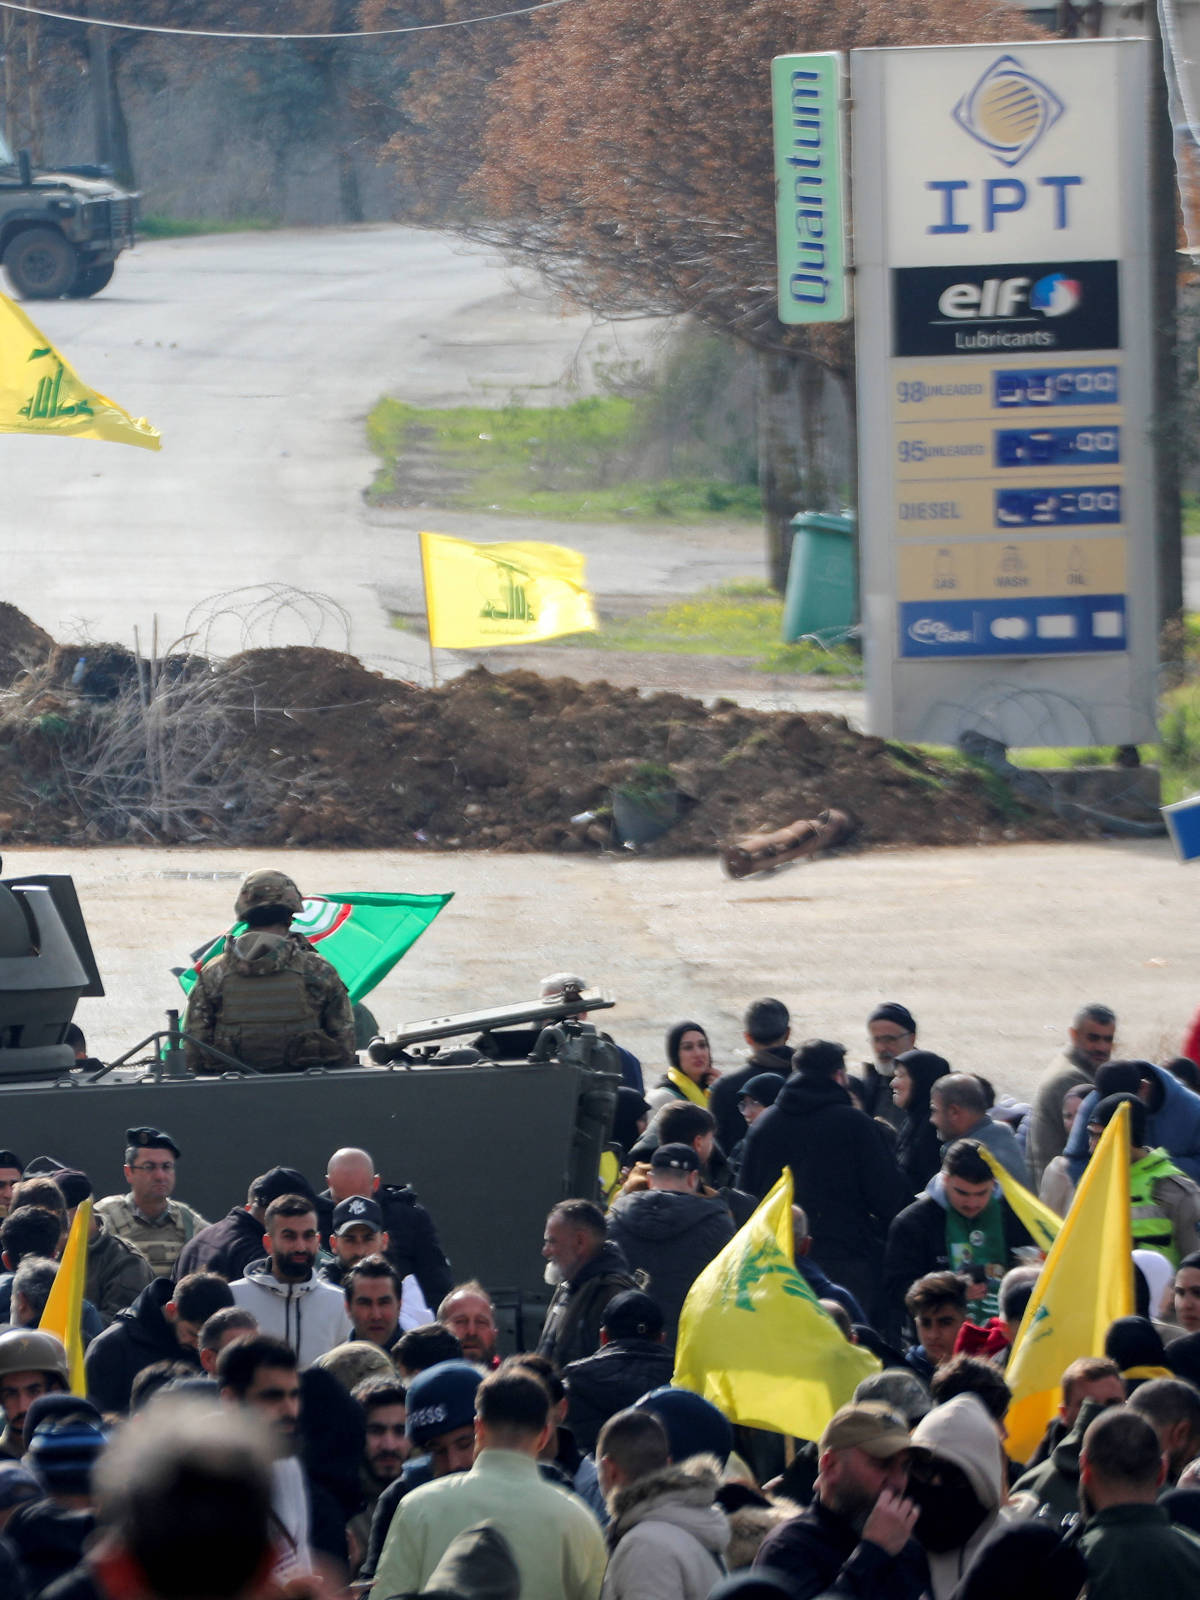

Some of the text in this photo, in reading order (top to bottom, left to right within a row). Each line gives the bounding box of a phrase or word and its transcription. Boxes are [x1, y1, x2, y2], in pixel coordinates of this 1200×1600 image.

[786, 71, 828, 304] Quantum
[926, 175, 1084, 235] IPT
[938, 276, 1031, 318] elf
[954, 331, 1054, 349] Lubricants
[896, 380, 926, 403] 98
[897, 440, 926, 463] 95
[899, 502, 961, 520] DIESEL
